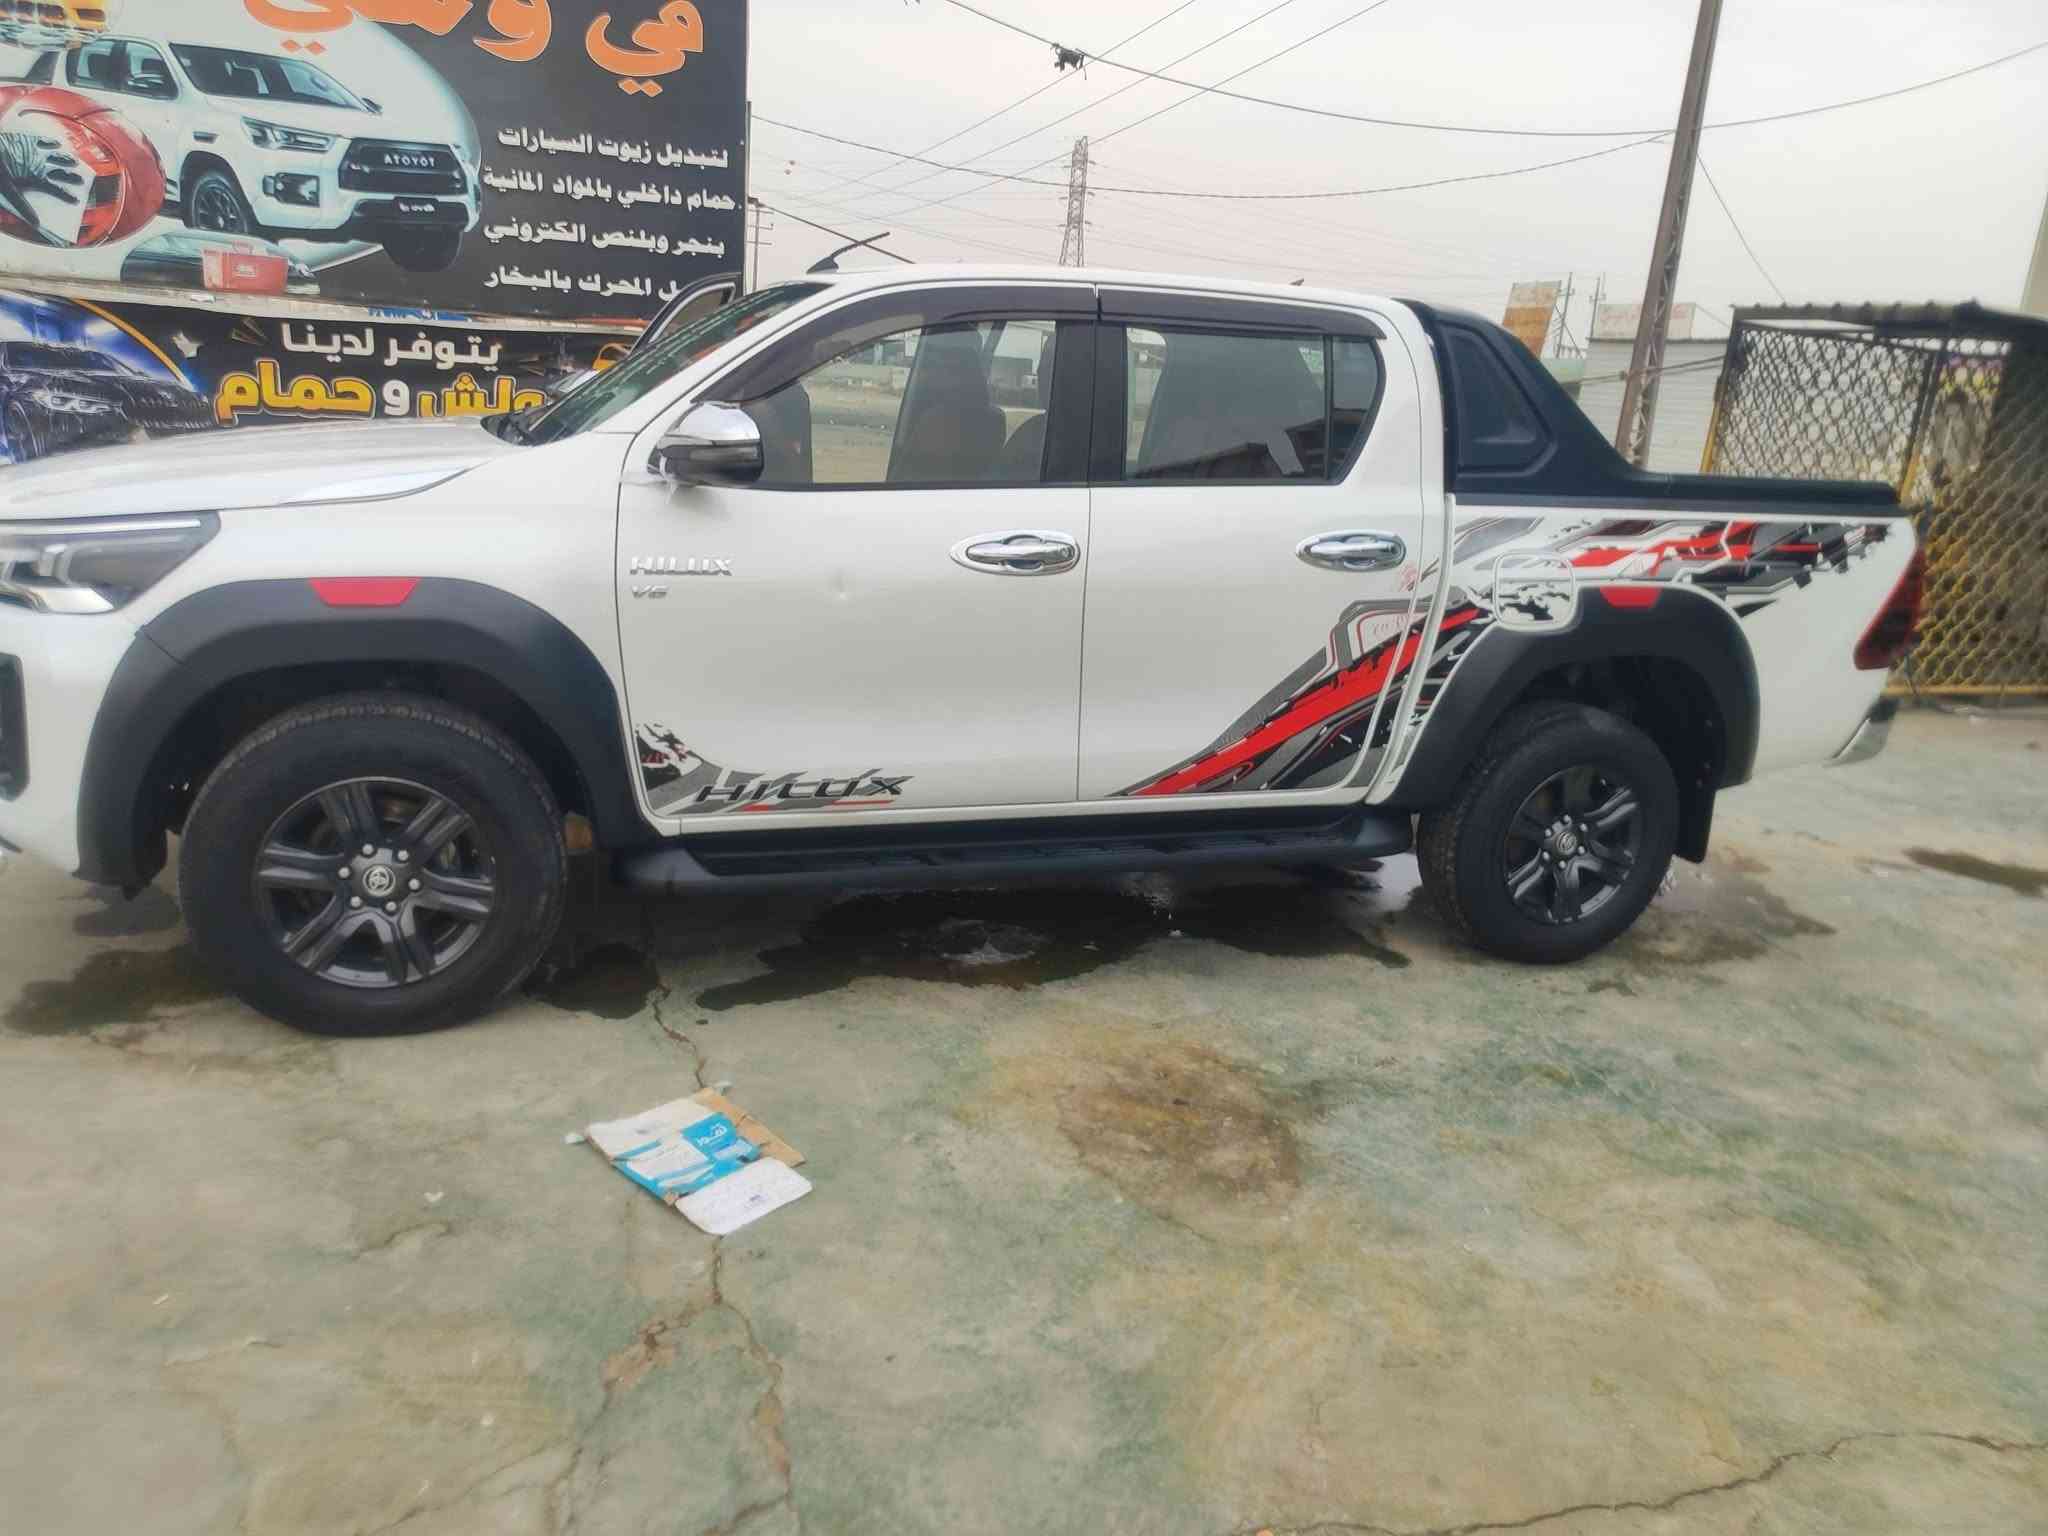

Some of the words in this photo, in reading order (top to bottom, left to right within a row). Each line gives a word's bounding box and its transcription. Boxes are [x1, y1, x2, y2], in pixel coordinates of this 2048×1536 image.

[498, 127, 593, 155] السيارات
[597, 138, 652, 165] زيوت
[656, 143, 729, 168] لتبديل
[553, 174, 612, 202] بالمواد
[617, 182, 682, 208] داخلي
[687, 188, 735, 212] حمام
[483, 216, 586, 243] الكتروني
[484, 264, 571, 293] بالبخار
[578, 273, 651, 297] المحرك
[281, 321, 374, 362] لدينا
[385, 331, 499, 371] يتوفر
[214, 358, 375, 425] حمام
[630, 556, 733, 576] HILUX
